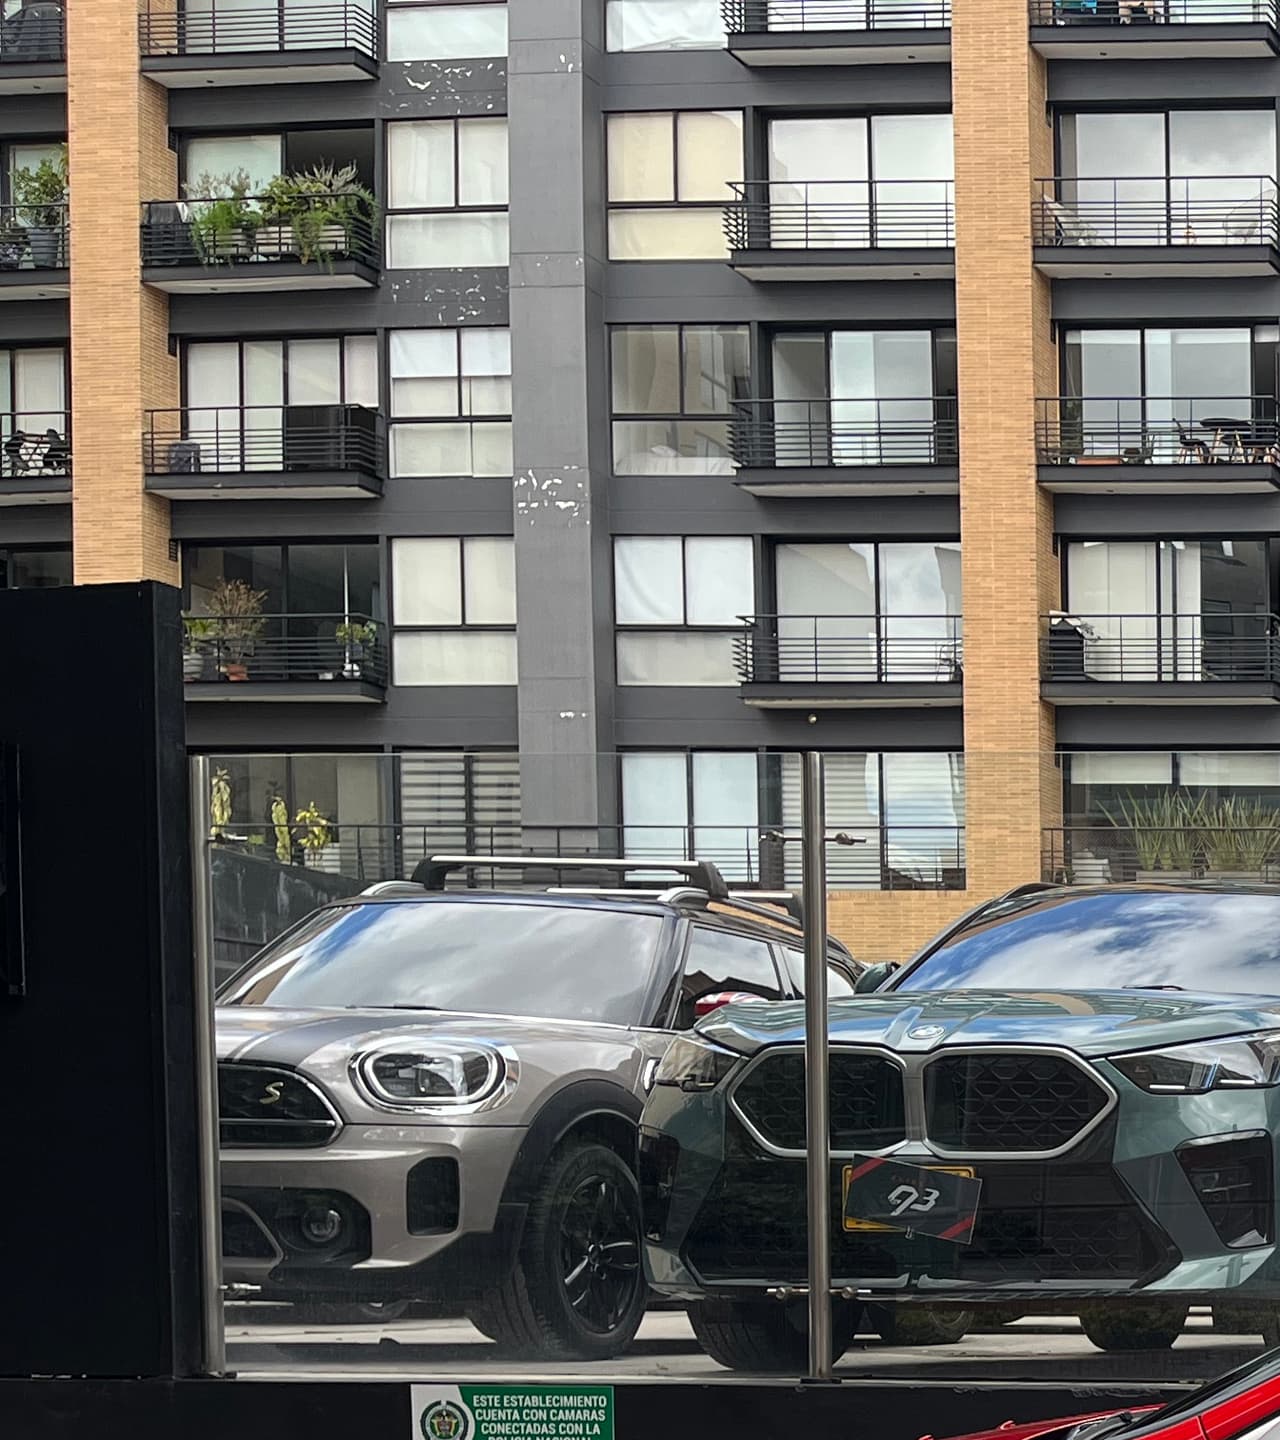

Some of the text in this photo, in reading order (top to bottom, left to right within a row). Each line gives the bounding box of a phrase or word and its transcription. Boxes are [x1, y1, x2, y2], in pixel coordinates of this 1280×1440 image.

[259, 1081, 284, 1105] S
[473, 1395, 607, 1407] ESTE ESTABLECIMIENTO
[475, 1409, 606, 1421] CUENTA CON CAMARAS
[481, 1423, 601, 1435] CONECTADAS CON LA
